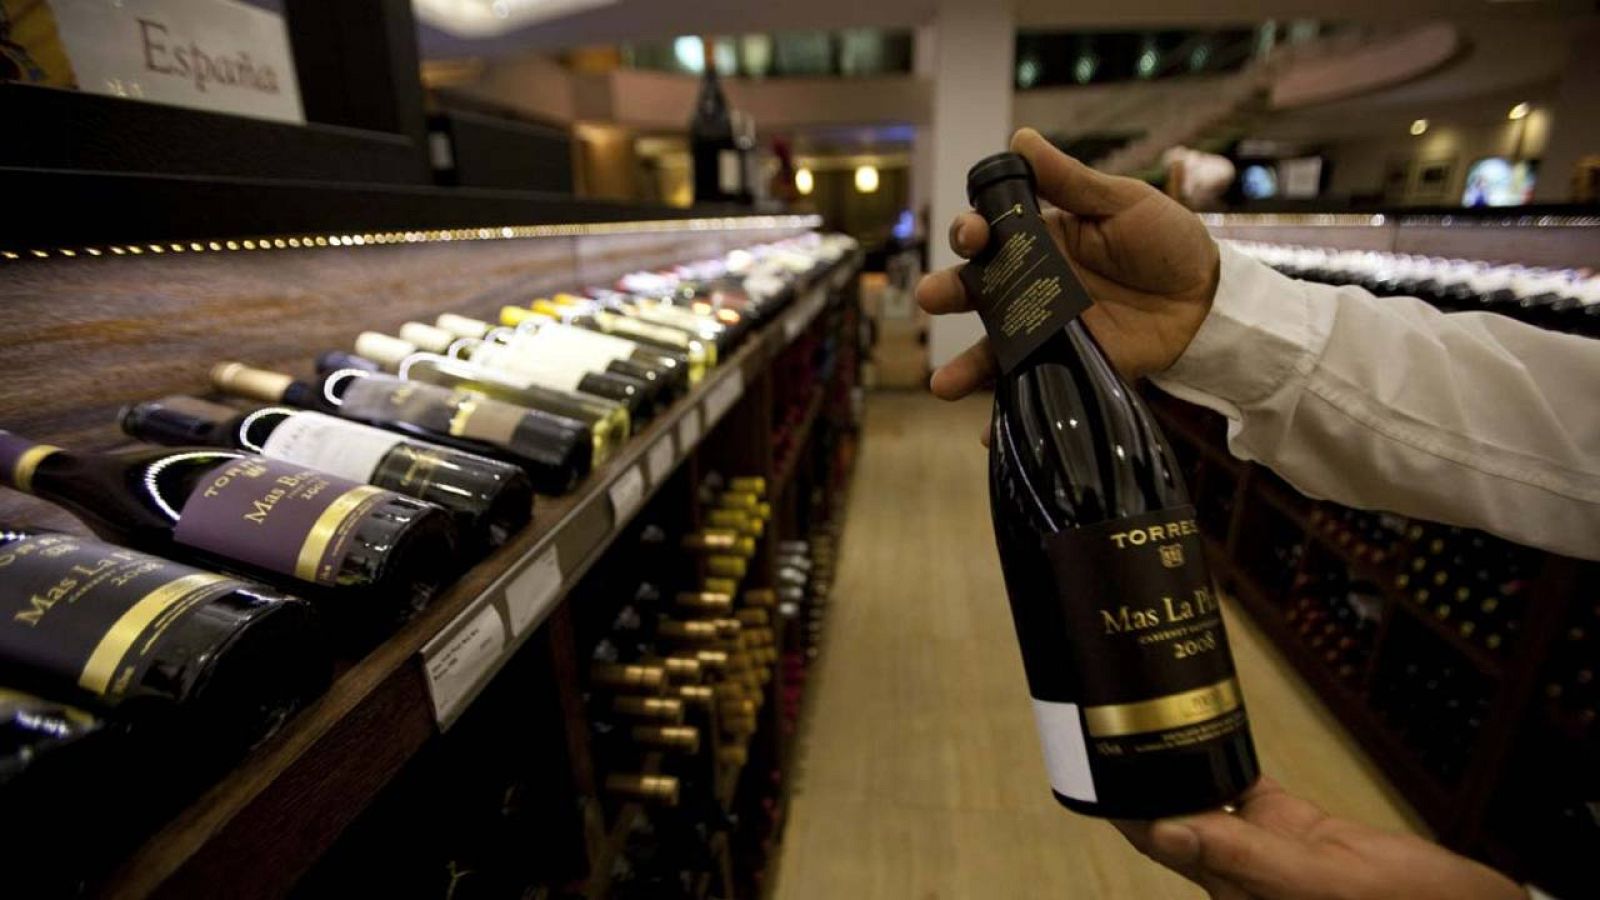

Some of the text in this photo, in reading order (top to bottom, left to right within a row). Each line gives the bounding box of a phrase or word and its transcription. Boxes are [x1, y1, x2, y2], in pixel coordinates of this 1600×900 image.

[138, 19, 280, 93] España
[243, 487, 286, 525] Mas
[14, 575, 78, 629] Mas
[1101, 606, 1160, 634] Mas
[1163, 597, 1195, 622] La
